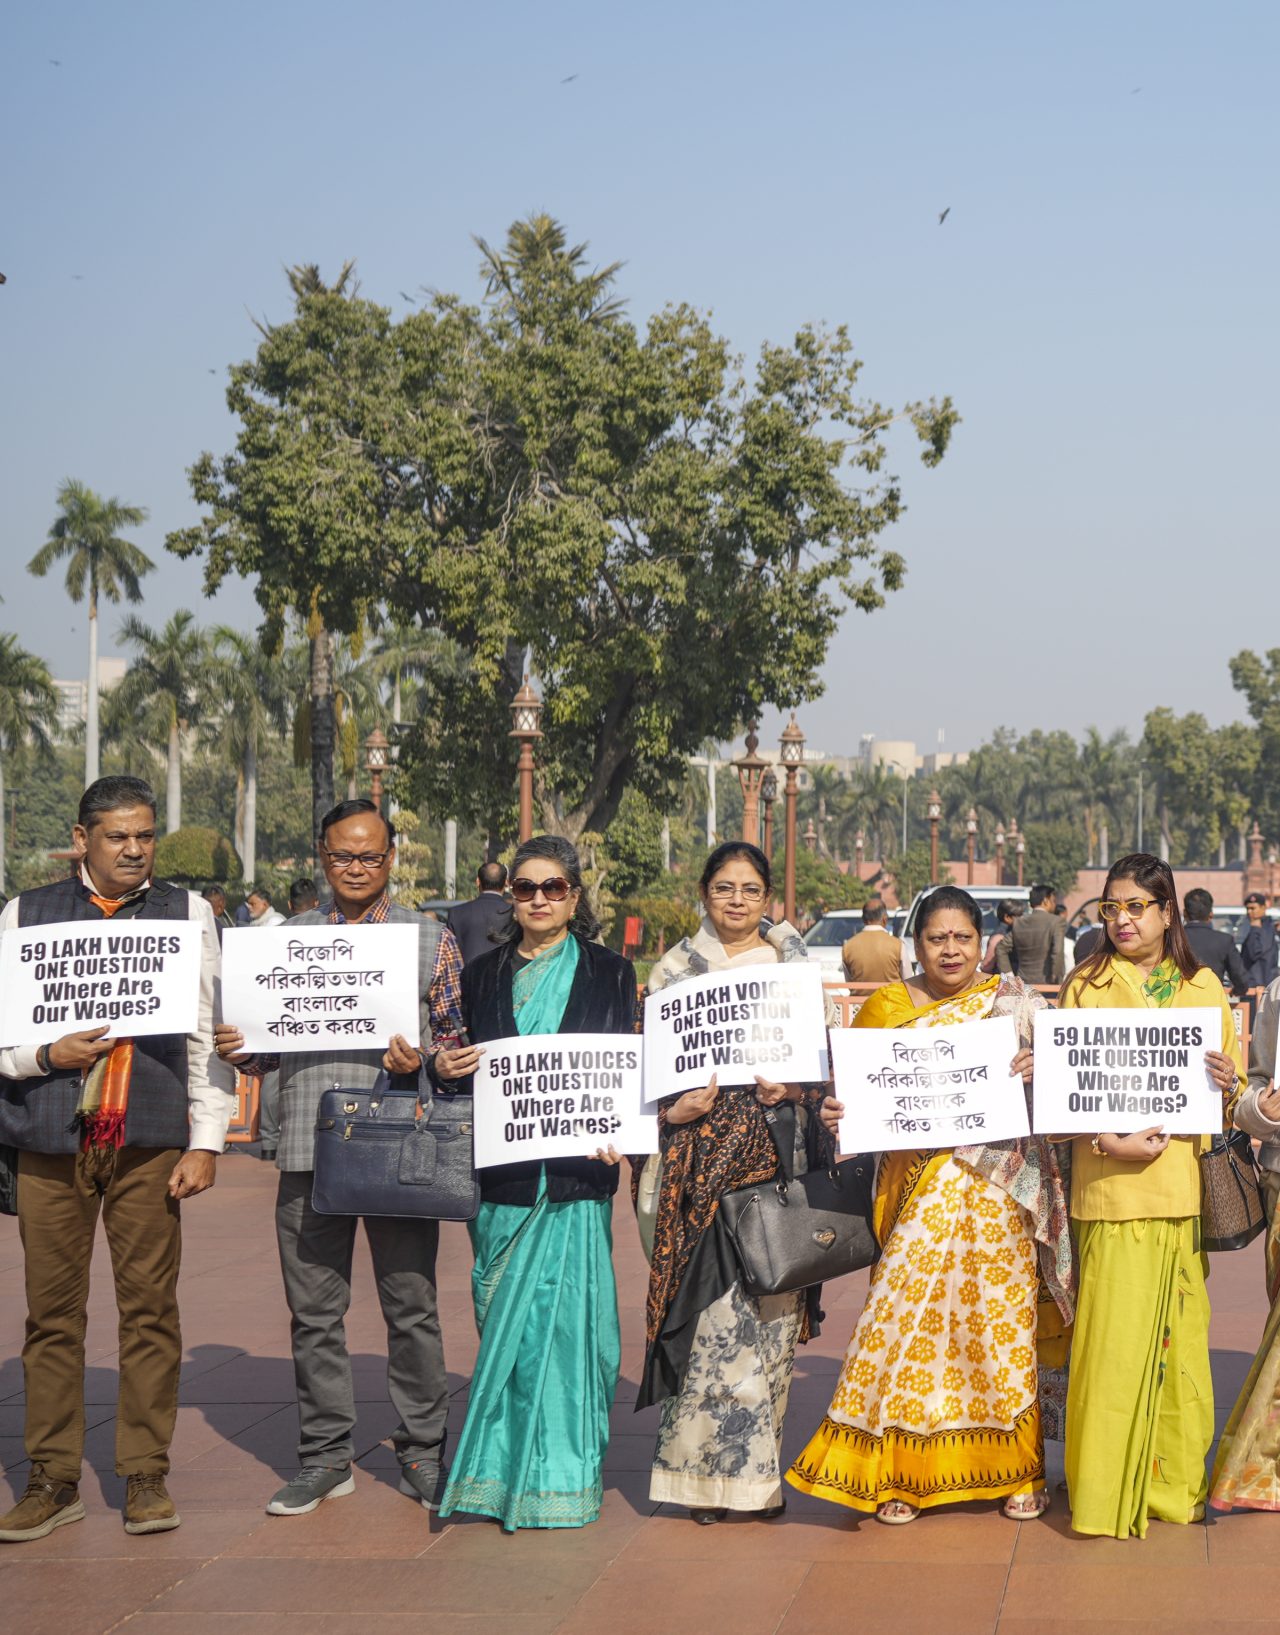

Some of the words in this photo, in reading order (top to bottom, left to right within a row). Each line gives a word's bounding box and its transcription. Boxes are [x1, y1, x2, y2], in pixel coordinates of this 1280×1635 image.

[20, 942, 47, 963] 59
[52, 937, 102, 959] LAKH
[108, 936, 181, 955] VOICES
[286, 938, 355, 962] বিজেপি
[34, 960, 68, 981] ONE
[73, 956, 164, 978] QUESTION
[255, 964, 385, 990] পরিকল্পিতভাবে
[43, 981, 112, 1002] Where
[117, 977, 153, 996] Are
[661, 998, 681, 1021] 59
[686, 985, 731, 1012] LAKH
[735, 981, 803, 1001] VOIC
[32, 1004, 69, 1024] Our
[74, 996, 161, 1020] Wages?
[282, 995, 359, 1013] বাংলাকে
[266, 1014, 321, 1037] বঞ্চিত
[324, 1018, 376, 1035] করছে
[673, 1011, 703, 1034] ONE
[707, 1002, 791, 1026] QUESTION
[681, 1027, 746, 1052] Where
[751, 1023, 784, 1043] Are
[1053, 1026, 1078, 1046] 59
[1083, 1026, 1130, 1046] LAKH
[1135, 1026, 1203, 1047] VOICES
[675, 1052, 707, 1074] Our
[711, 1043, 793, 1066] Wages?
[891, 1039, 955, 1063] বিজেপি
[1068, 1048, 1100, 1067] ONE
[1104, 1048, 1188, 1069] QUESTION
[489, 1056, 511, 1078] 59
[516, 1051, 562, 1074] LAKH
[568, 1051, 637, 1070] VOICES
[502, 1076, 532, 1097] ONE
[537, 1072, 623, 1094] QUESTION
[1077, 1071, 1143, 1091] Where
[1146, 1071, 1180, 1092] Are
[511, 1097, 575, 1120] Where
[580, 1093, 614, 1113] Are
[893, 1092, 967, 1111] বাংলাকে
[1068, 1092, 1103, 1113] Our
[1107, 1092, 1188, 1115] Wages?
[504, 1122, 536, 1143] Our
[934, 1112, 986, 1132] রছে
